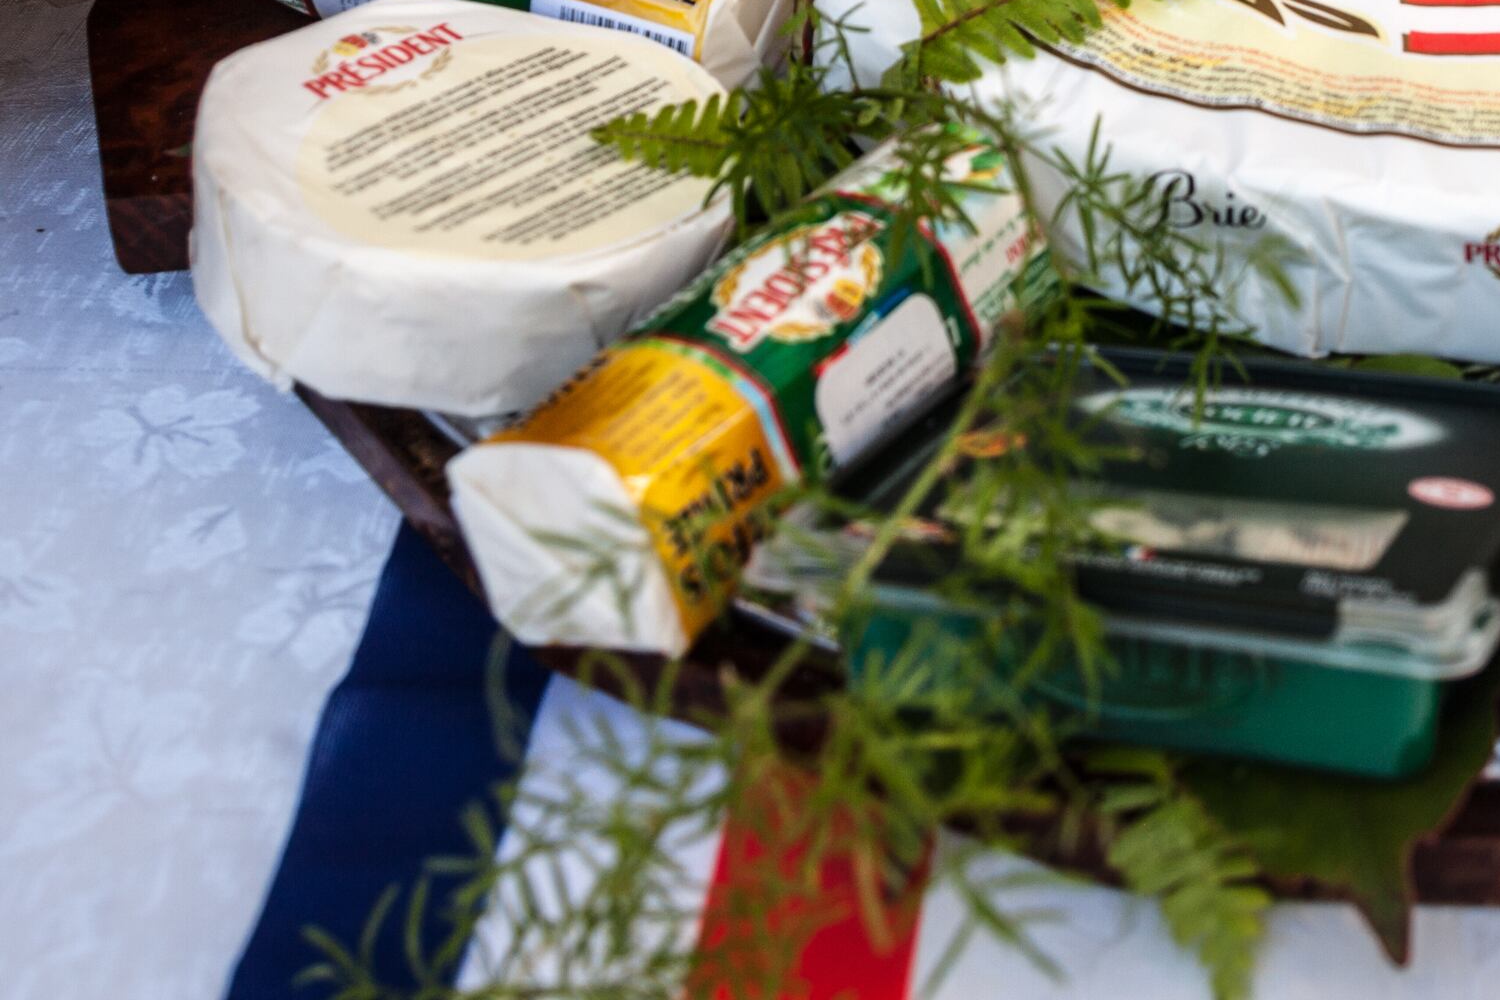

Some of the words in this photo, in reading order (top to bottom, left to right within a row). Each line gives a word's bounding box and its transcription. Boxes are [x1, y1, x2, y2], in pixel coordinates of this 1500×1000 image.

[303, 22, 465, 100] PRÉSIDENT
[1144, 169, 1268, 232] Brie
[708, 211, 886, 351] PRÉSIDENT
